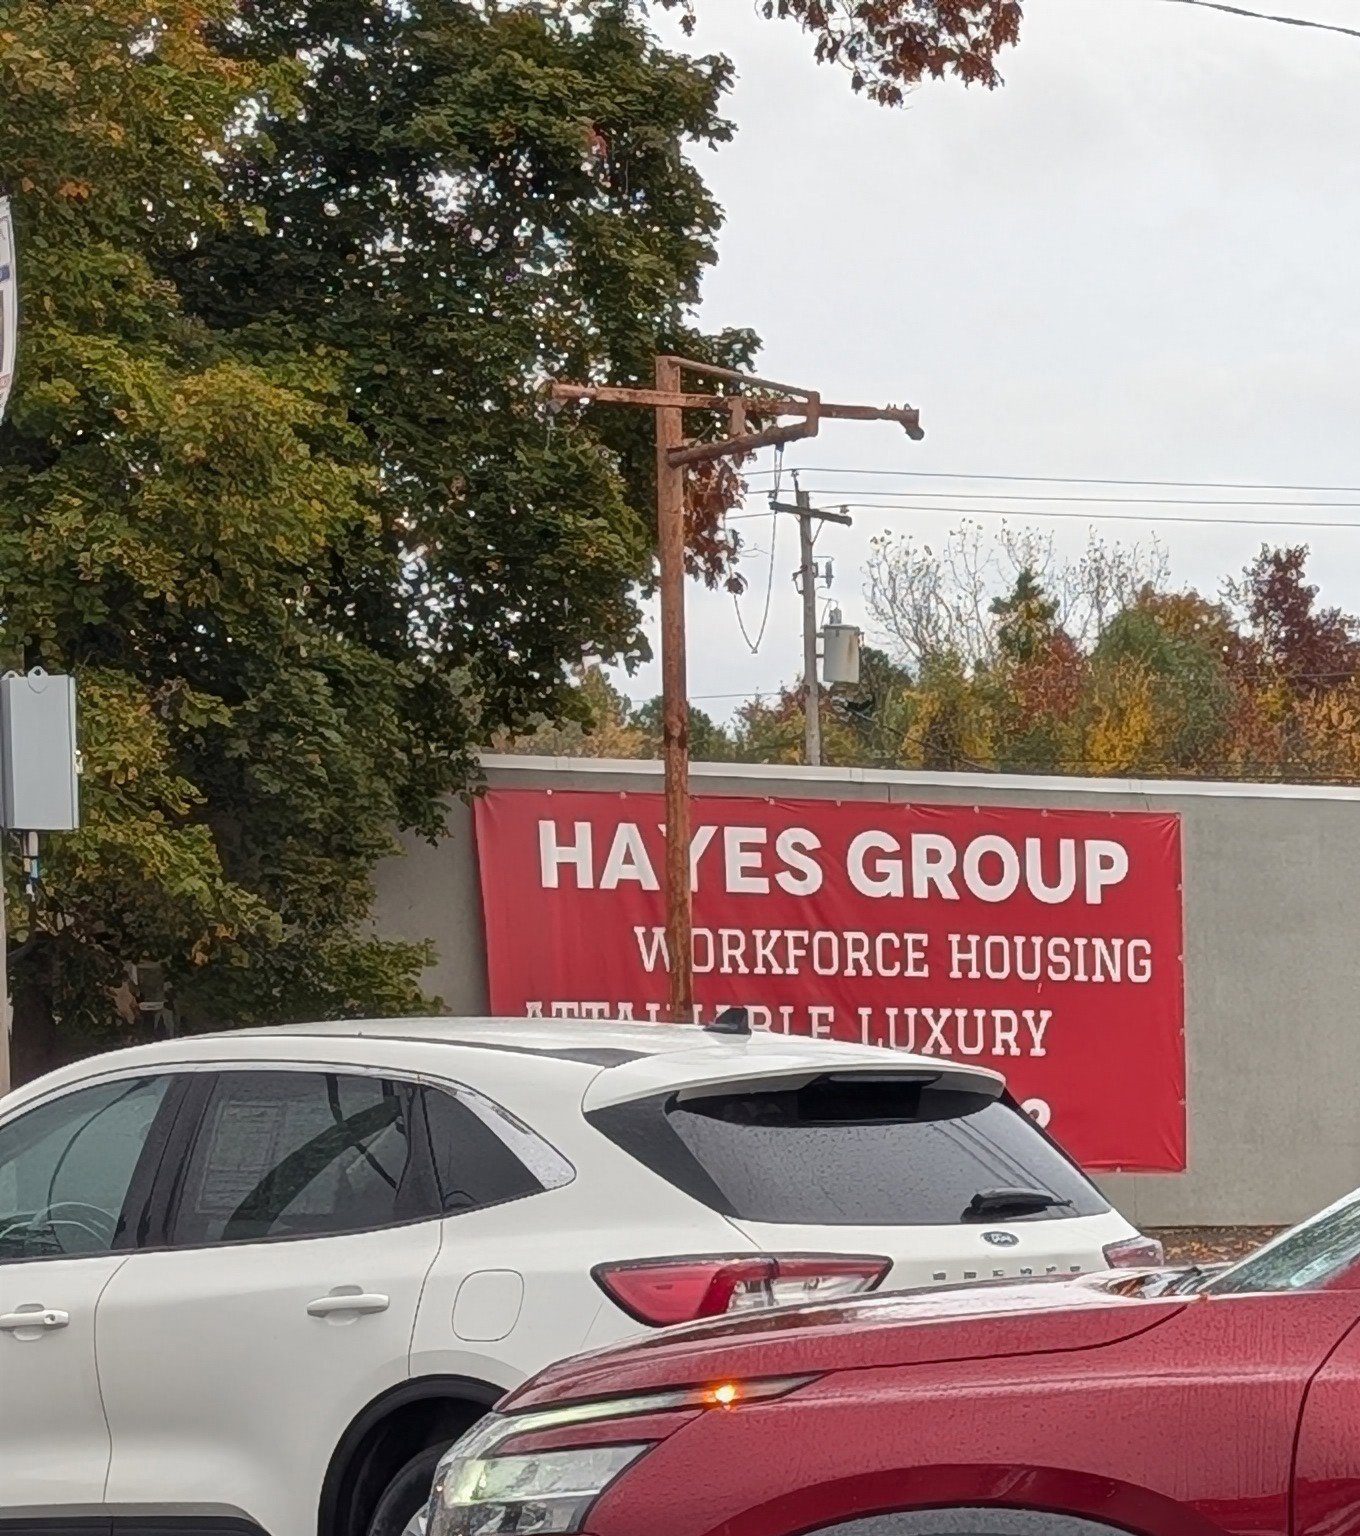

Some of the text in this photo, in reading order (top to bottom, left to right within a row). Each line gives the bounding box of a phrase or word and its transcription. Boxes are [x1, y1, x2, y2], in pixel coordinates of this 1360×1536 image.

[538, 819, 1130, 905] HAYES GROUP
[633, 925, 1152, 984] WORKFORCE HOUSING
[858, 1006, 1053, 1057] LUXURY
